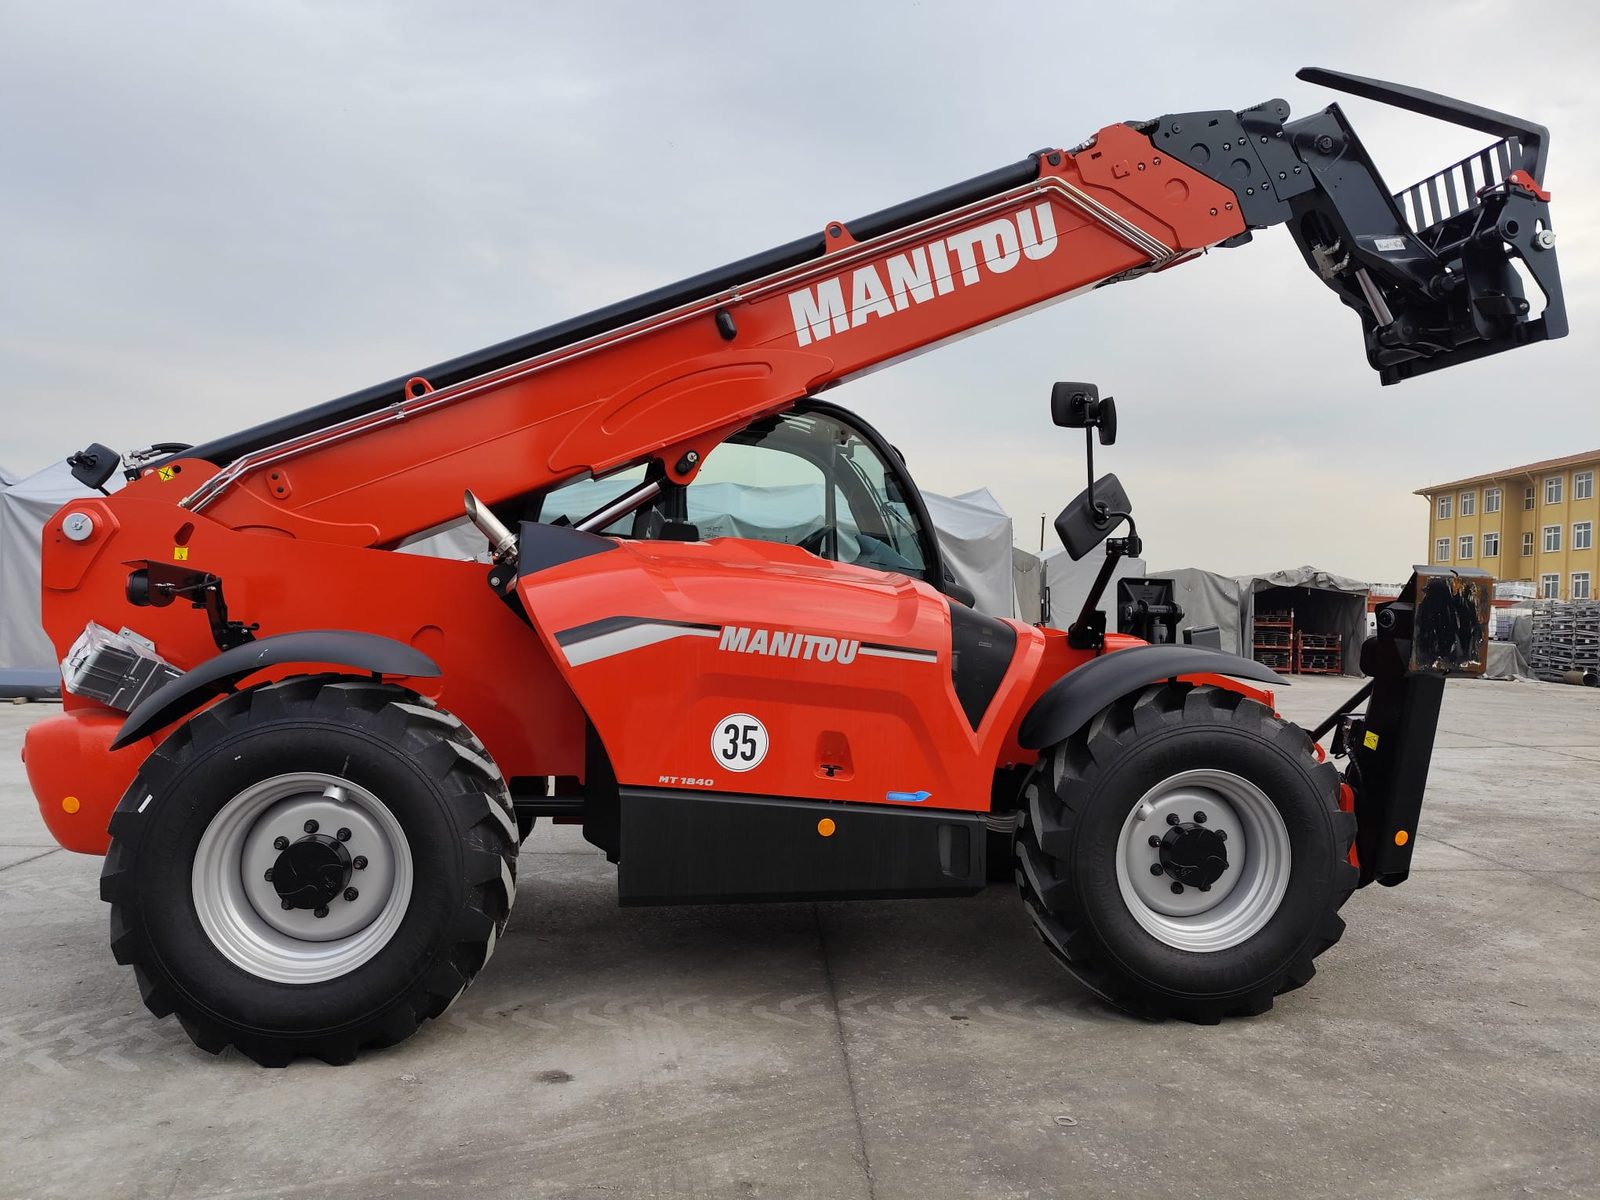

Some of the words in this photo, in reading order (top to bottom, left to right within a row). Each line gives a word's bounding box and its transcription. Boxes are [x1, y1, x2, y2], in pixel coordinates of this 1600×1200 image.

[788, 201, 1058, 347] MANITOU
[719, 625, 859, 665] MANITOU
[722, 723, 758, 761] 35
[659, 775, 678, 784] MT
[680, 777, 714, 786] 1840
